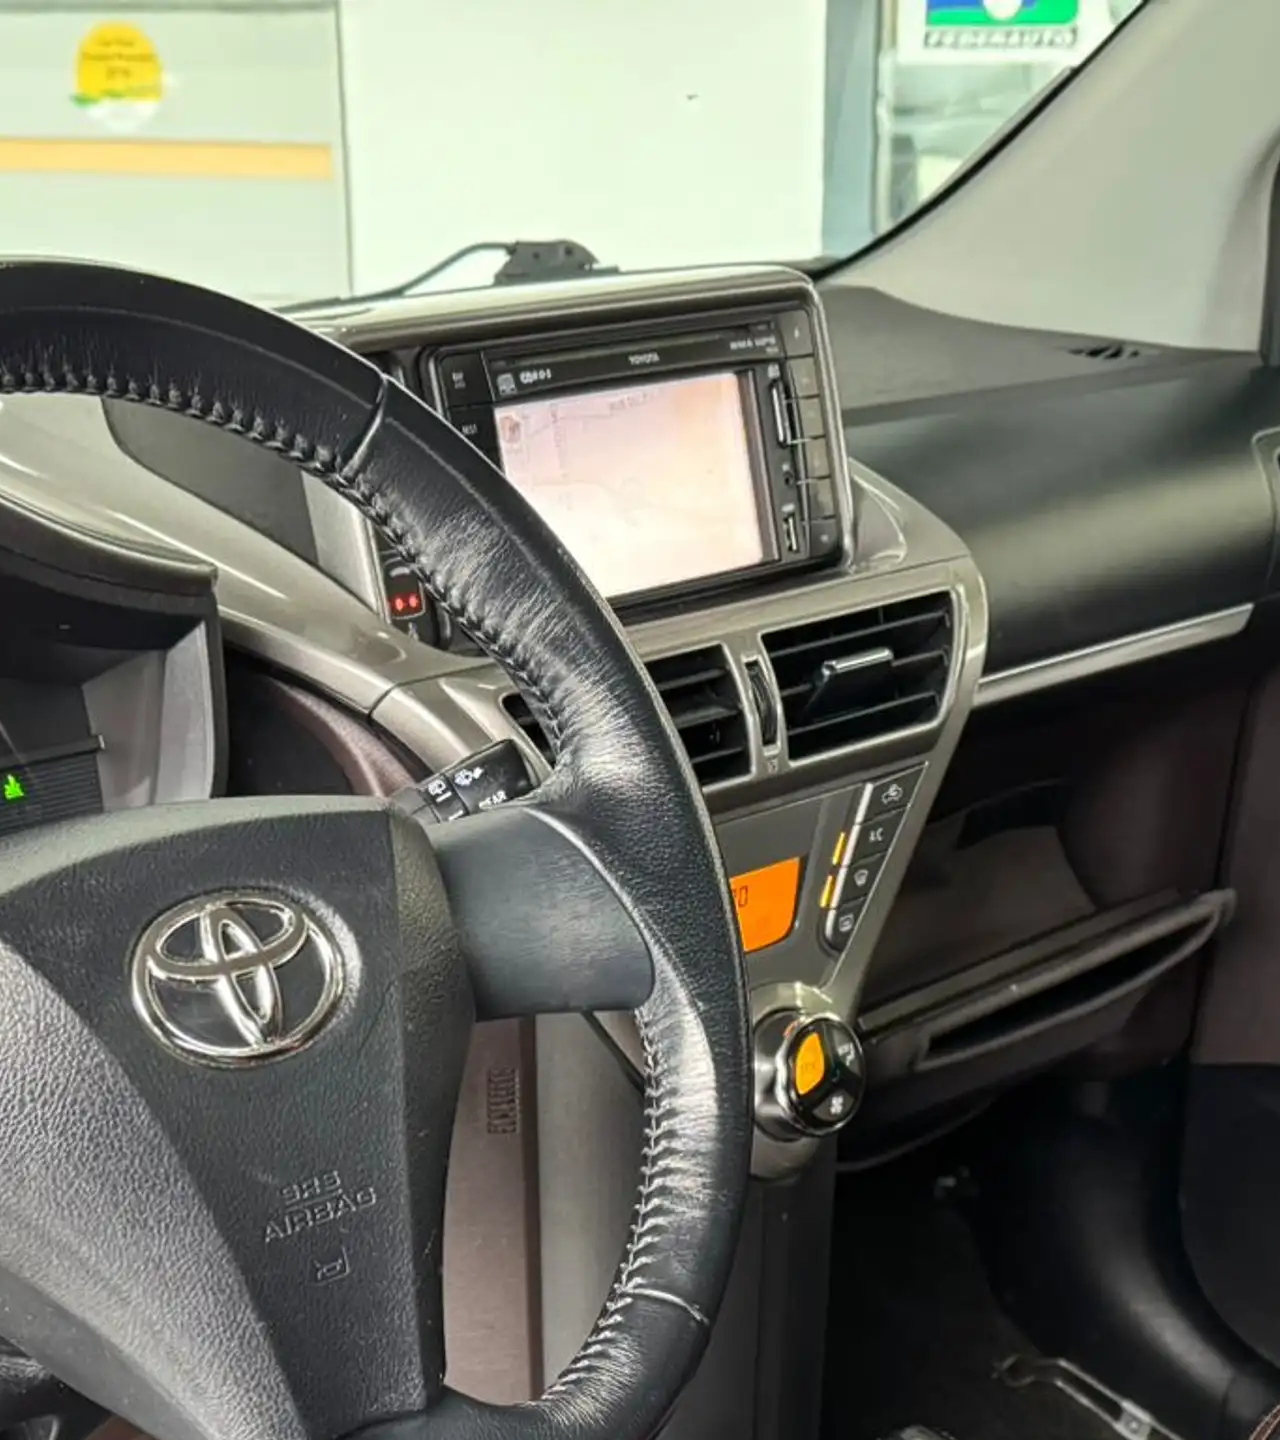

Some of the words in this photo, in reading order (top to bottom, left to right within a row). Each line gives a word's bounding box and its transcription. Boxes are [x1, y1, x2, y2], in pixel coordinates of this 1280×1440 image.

[628, 352, 660, 366] TOYOTA
[281, 1170, 341, 1203] SRS
[264, 1187, 377, 1243] AIRBAG
